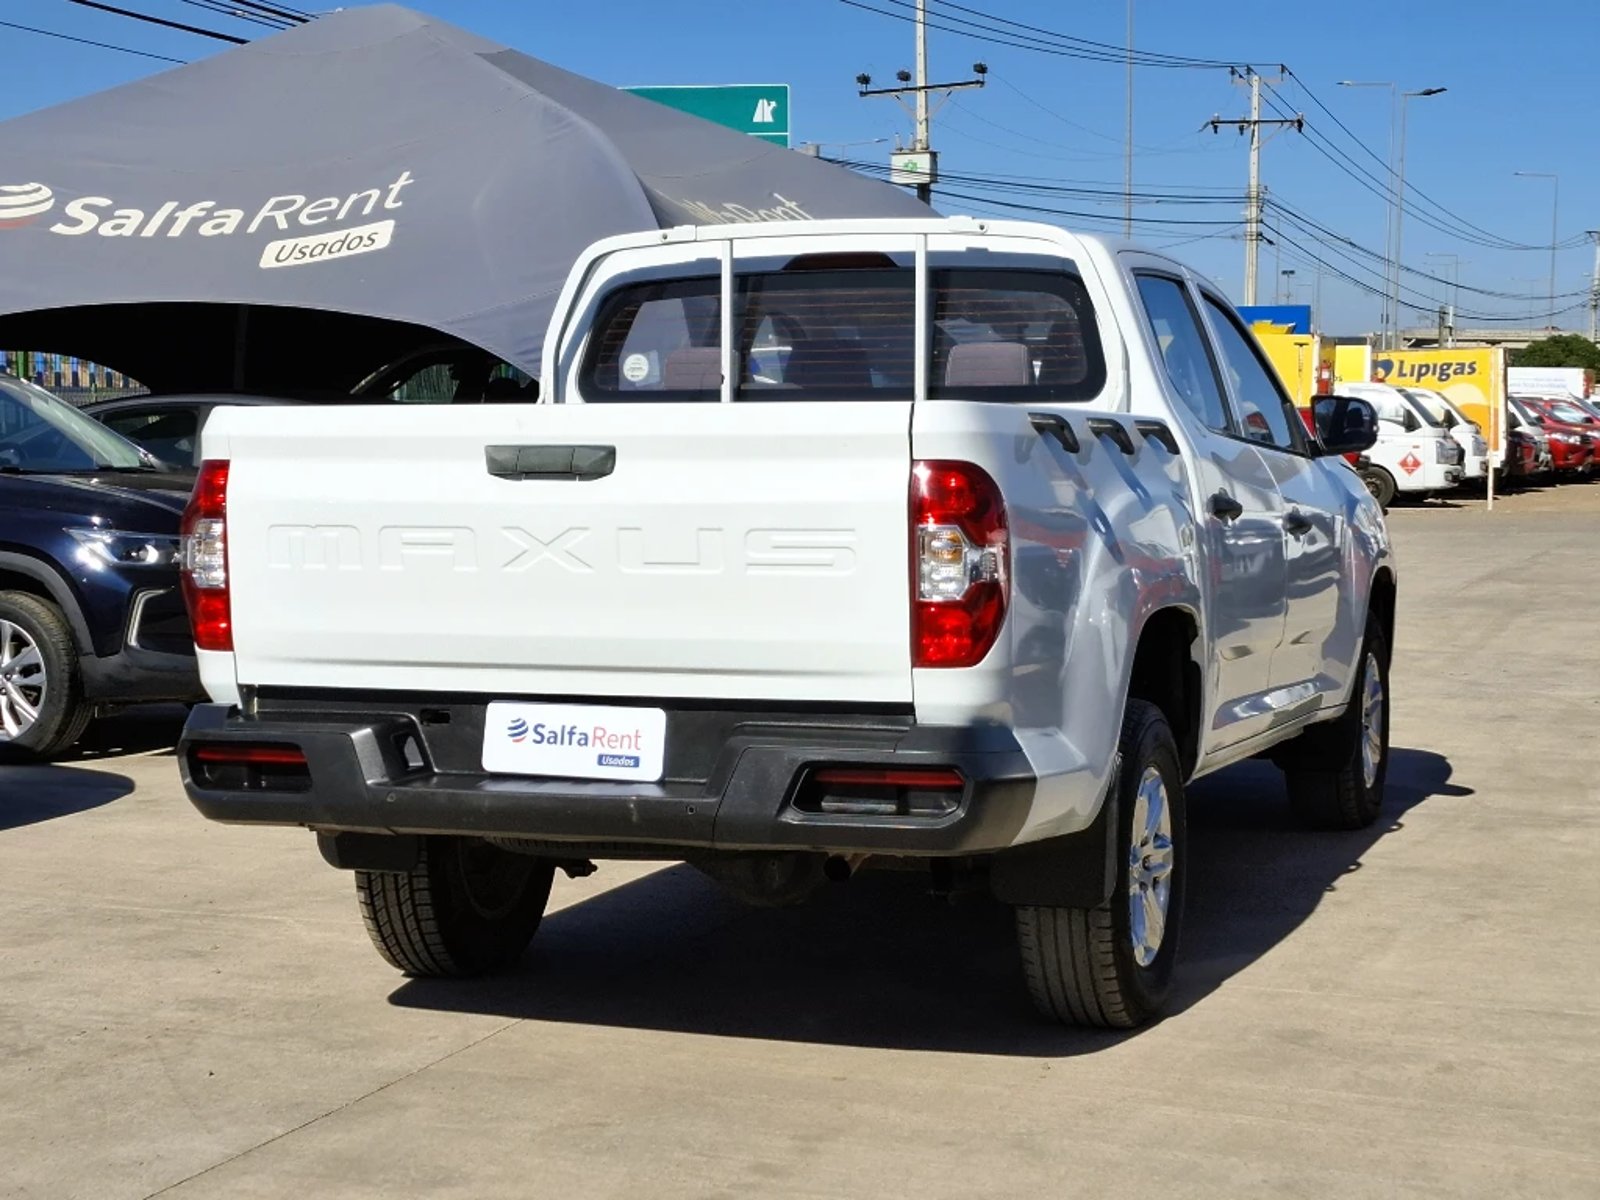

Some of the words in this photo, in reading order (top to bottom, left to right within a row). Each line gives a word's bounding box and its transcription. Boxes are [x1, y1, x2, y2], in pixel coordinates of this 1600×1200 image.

[50, 171, 414, 237] SalfaRent
[274, 229, 379, 263] Usados
[1397, 359, 1477, 383] Lipigas
[267, 524, 857, 576] MAXUS
[532, 723, 642, 751] SalfaRent
[602, 756, 635, 767] Usados
